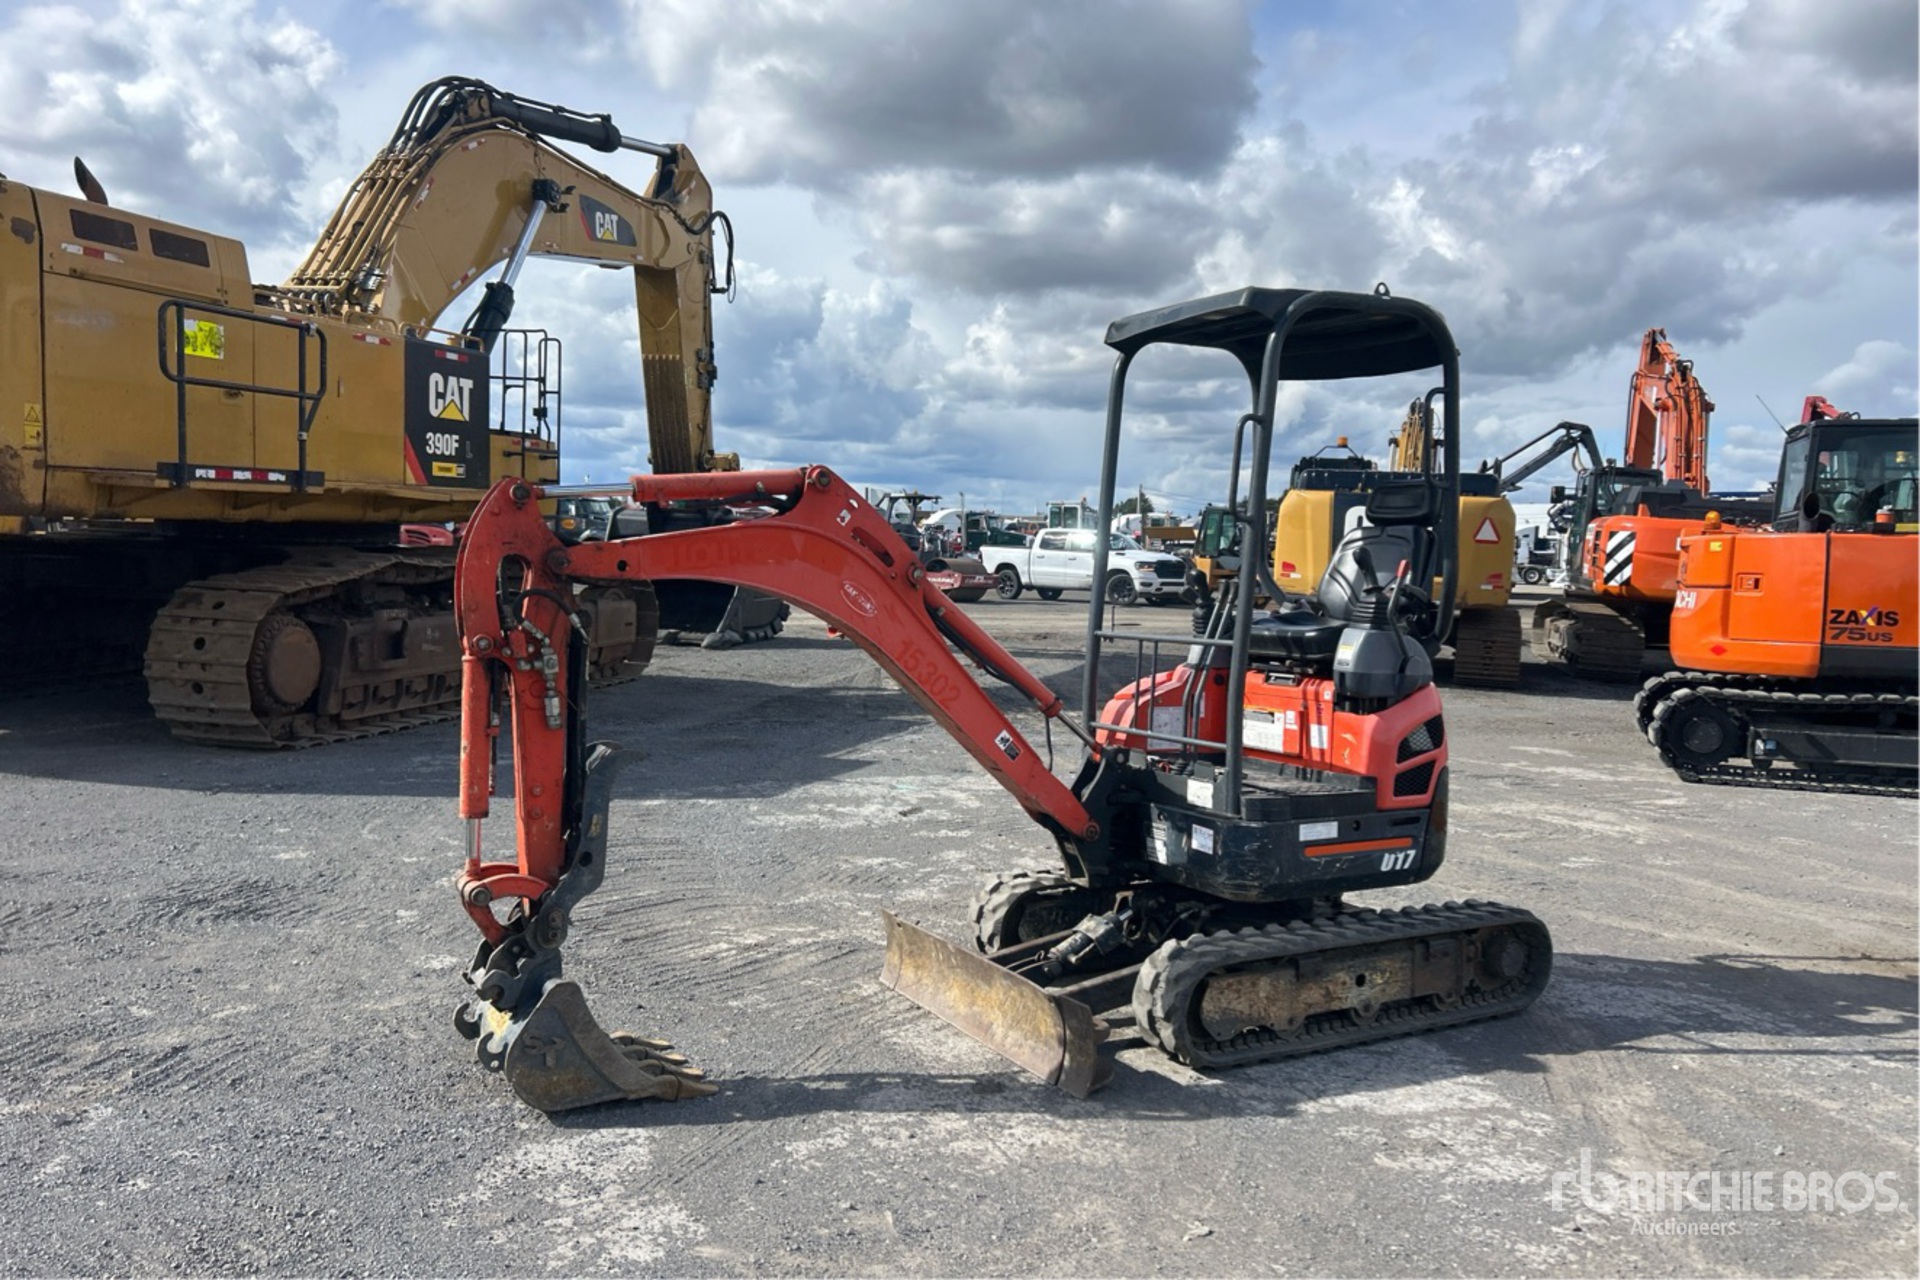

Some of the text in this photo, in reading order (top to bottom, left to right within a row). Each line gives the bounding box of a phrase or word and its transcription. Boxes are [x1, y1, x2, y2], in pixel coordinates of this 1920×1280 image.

[595, 211, 619, 241] CAT
[428, 372, 474, 422] CAT
[425, 432, 459, 456] 390F
[1829, 606, 1899, 627] ZAXIS
[1829, 627, 1893, 642] 75US
[898, 641, 961, 702] 15302
[1380, 849, 1416, 872] U17
